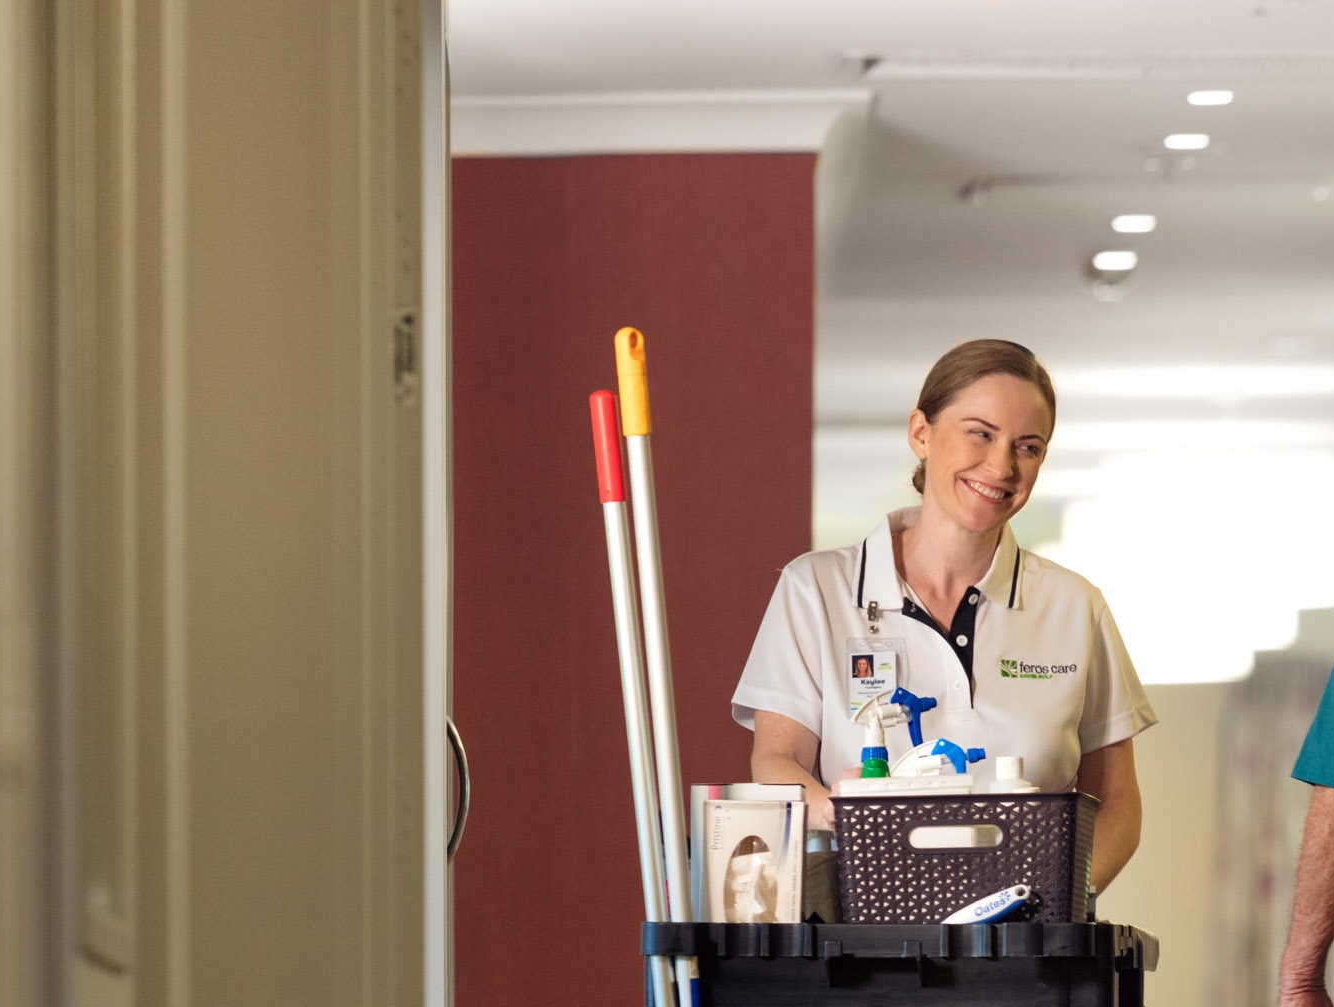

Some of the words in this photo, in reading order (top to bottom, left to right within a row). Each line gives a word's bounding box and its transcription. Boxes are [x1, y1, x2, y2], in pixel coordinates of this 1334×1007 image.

[1019, 661, 1049, 674] feros
[1051, 664, 1077, 674] care
[974, 898, 1006, 916] Oates
